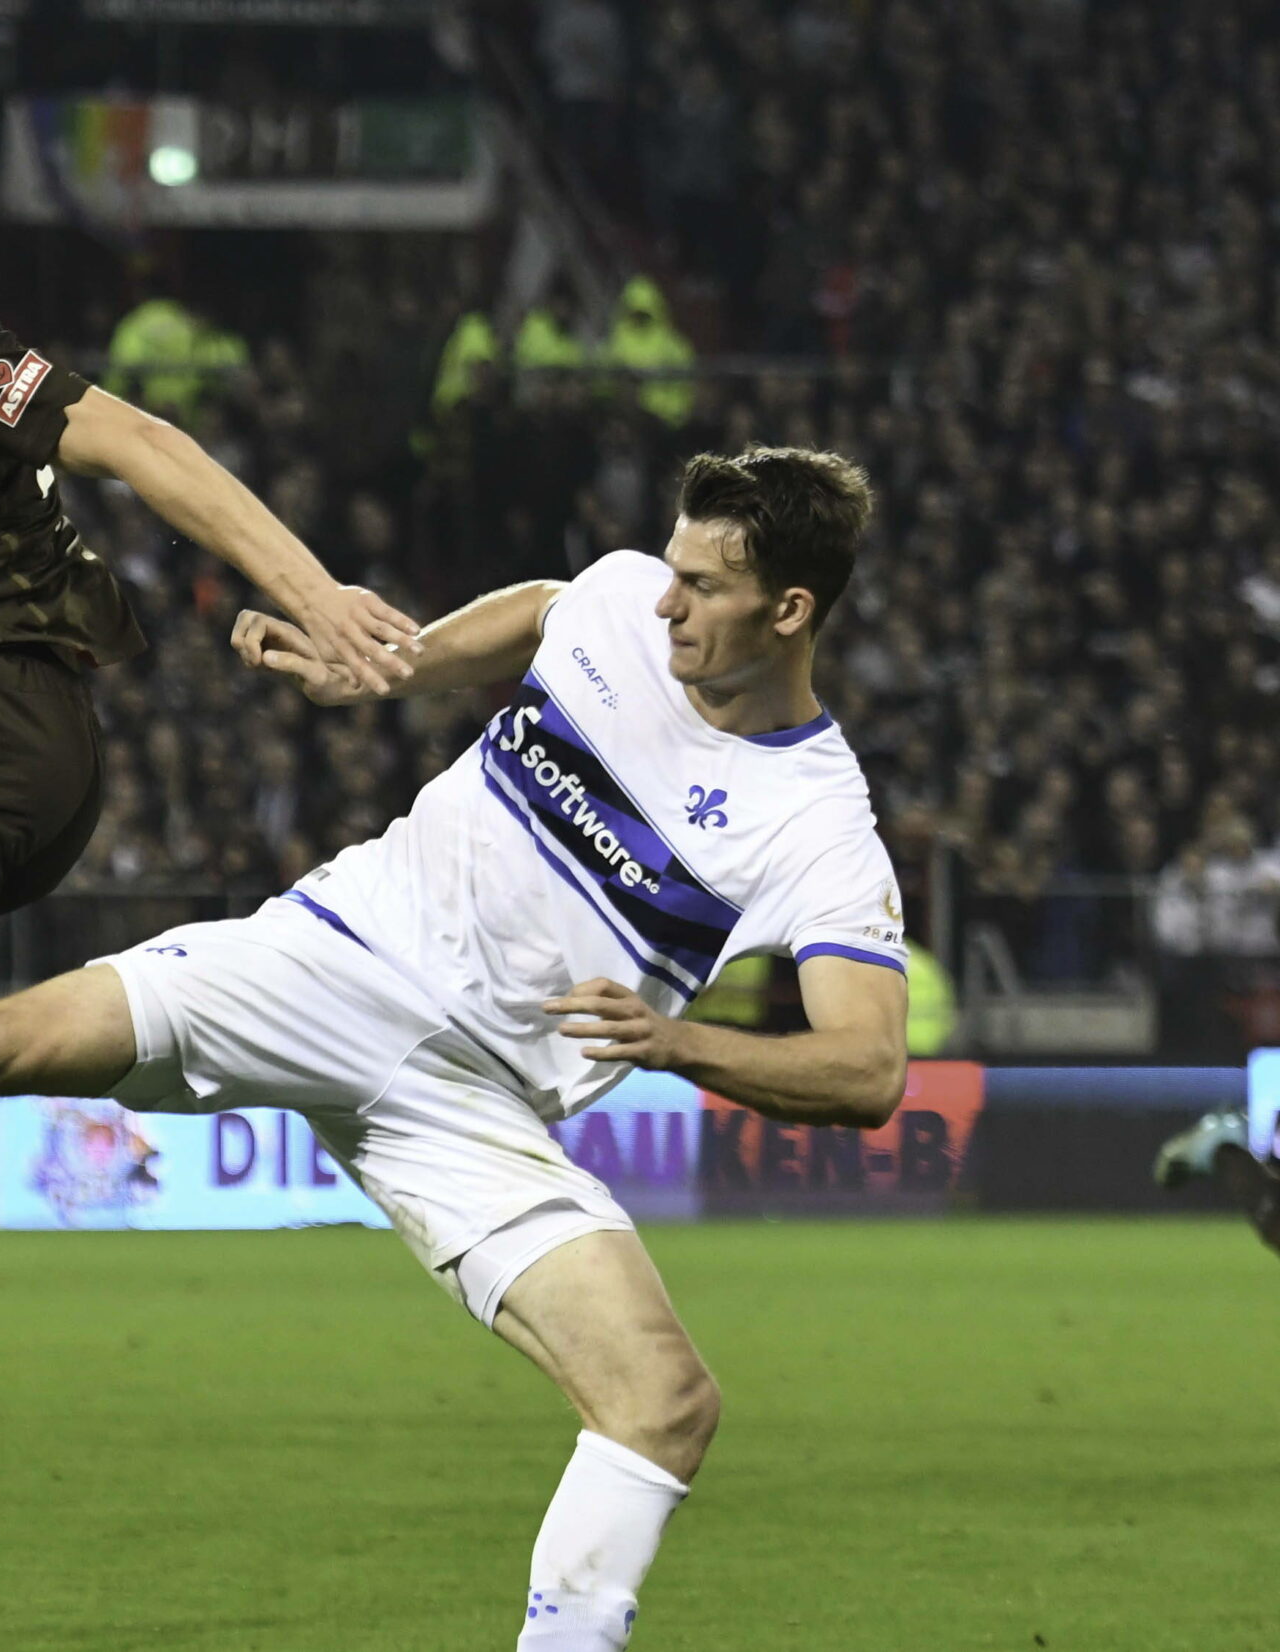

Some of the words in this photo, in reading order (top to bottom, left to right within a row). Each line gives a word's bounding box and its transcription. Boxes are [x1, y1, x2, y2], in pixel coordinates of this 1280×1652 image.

[1, 361, 44, 419] ASTRA
[571, 647, 611, 693] CRAFT
[521, 744, 643, 888] software
[641, 877, 661, 895] AG
[862, 926, 881, 939] 28
